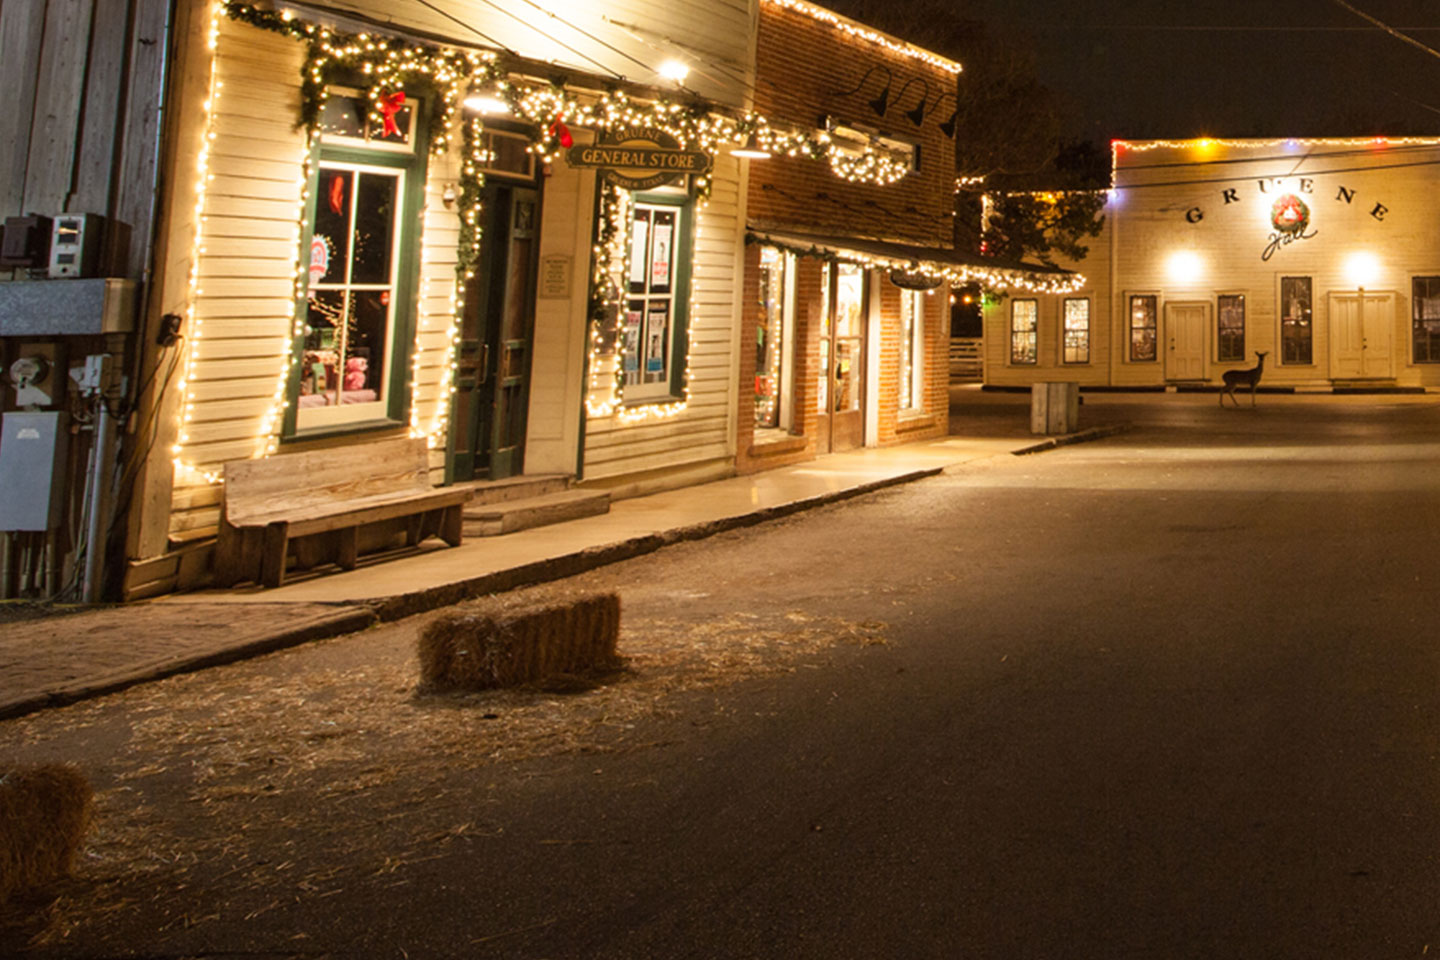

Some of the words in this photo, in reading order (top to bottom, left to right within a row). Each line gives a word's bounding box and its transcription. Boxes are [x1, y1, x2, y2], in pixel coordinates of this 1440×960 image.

[615, 127, 662, 142] GRUENE
[581, 148, 647, 167] GENERAL
[649, 152, 696, 168] STORE
[1185, 178, 1389, 224] GRUENE
[1261, 224, 1318, 262] Hall
